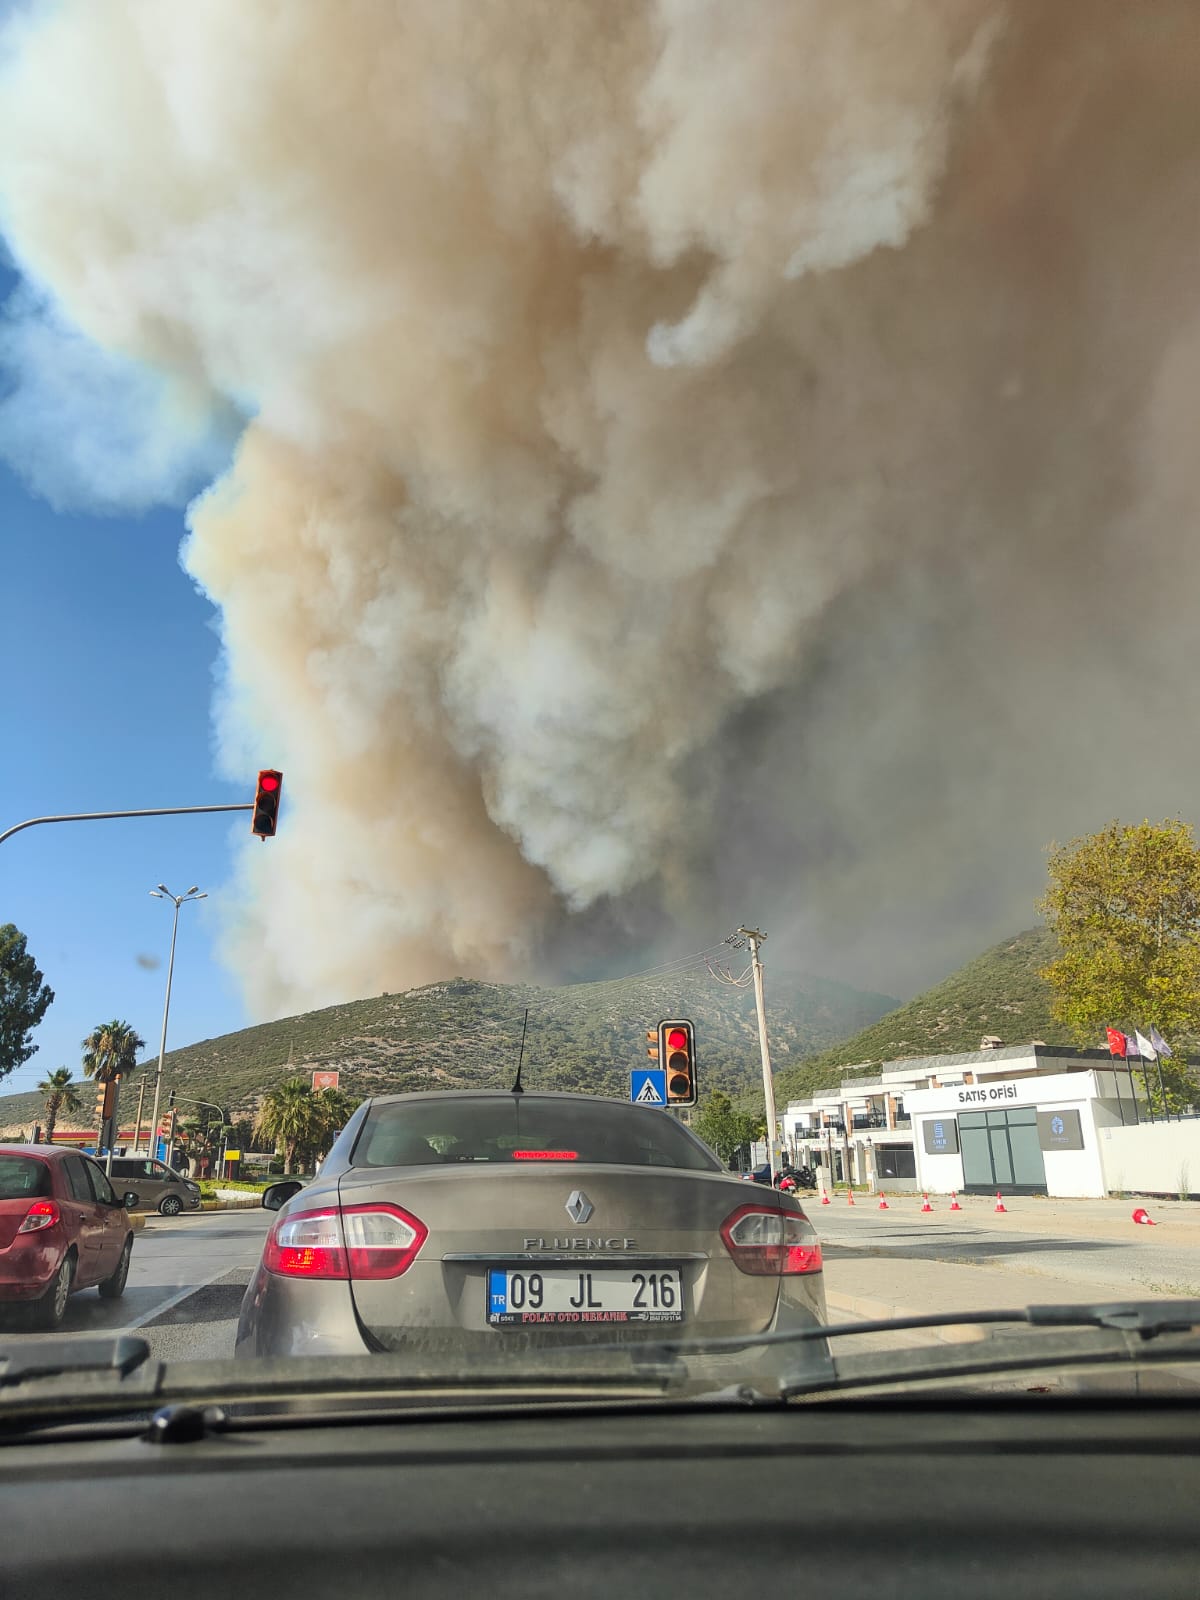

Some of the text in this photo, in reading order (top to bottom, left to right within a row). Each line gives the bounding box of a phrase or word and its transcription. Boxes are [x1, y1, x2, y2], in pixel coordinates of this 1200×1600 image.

[958, 1084, 1018, 1103] SATIŞ OFİSİ
[523, 1238, 639, 1250] FLUENCE
[510, 1273, 675, 1309] 09 JL 216
[492, 1294, 505, 1305] TR
[522, 1312, 556, 1323] POLAT
[558, 1312, 580, 1322] OTO
